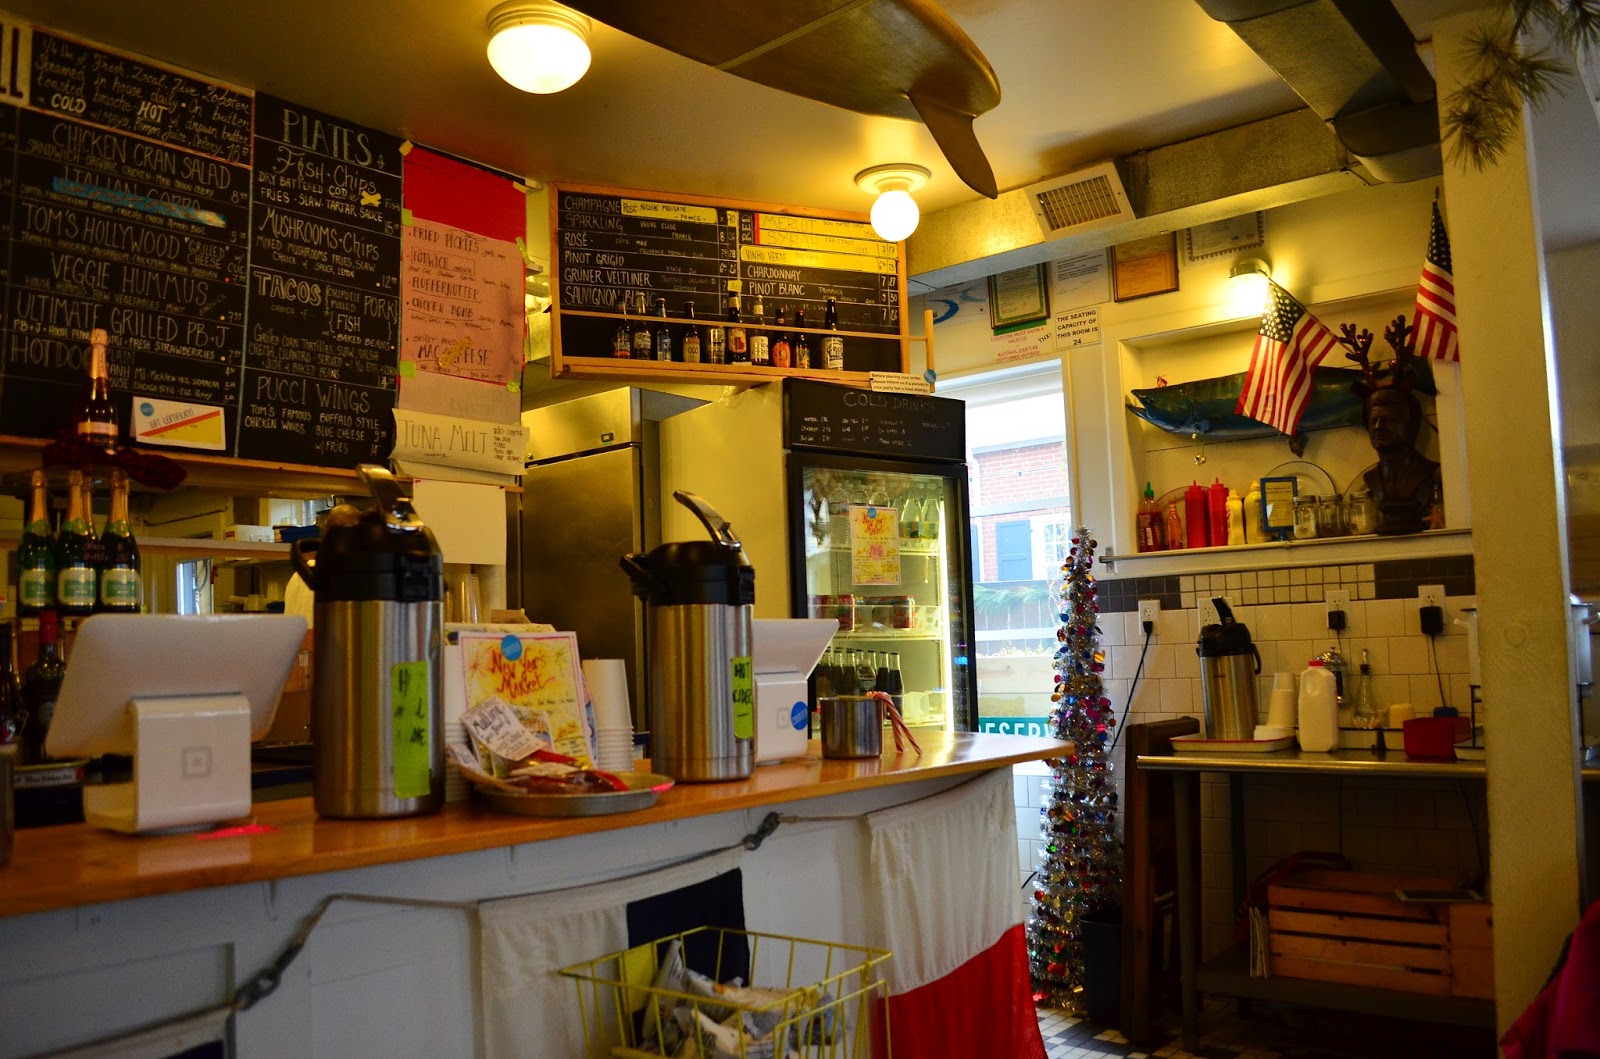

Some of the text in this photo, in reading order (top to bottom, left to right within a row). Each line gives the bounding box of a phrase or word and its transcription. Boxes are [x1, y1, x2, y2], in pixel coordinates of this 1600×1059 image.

[51, 93, 87, 114] COLD
[137, 101, 168, 124] HOT
[282, 109, 372, 166] PLATES
[52, 122, 231, 189] CHICKEN CRAN SALAD
[258, 170, 348, 198] DRY BATTERED COD
[260, 187, 384, 223] FRIES SLAW TARTAR SAUCE
[564, 195, 620, 214] CHAMPAGNE
[21, 202, 180, 259] TOM'S HOLLYWOOD
[258, 207, 380, 261] MUSHROOMS Chips
[565, 213, 624, 234] SPARKLING
[741, 214, 752, 242] RED
[762, 215, 817, 234] MERLOT
[256, 235, 283, 251] MIXED
[287, 242, 328, 263] MUSHROOMS
[413, 226, 480, 254] FRIED PICKLES
[564, 231, 588, 247] ROSÉ
[767, 231, 819, 250] SYRAH
[187, 253, 222, 270] CHEESE
[272, 250, 297, 266] CHOICE
[564, 249, 625, 267] PINOT GRIGIO
[745, 249, 765, 260] VINHO
[51, 251, 111, 289] VEGGIE
[121, 265, 209, 306] HUMMUS
[607, 270, 653, 288] VELTLINER
[747, 265, 896, 287] CHARDONNAY 7 27
[253, 270, 322, 307] TACOS
[363, 295, 395, 321] PORK
[412, 277, 480, 301] FLUFFERNUTTER
[749, 281, 897, 303] PINOT BLANC 30
[16, 291, 179, 342] ULTIMATE GRILLED
[411, 297, 474, 318] CHICKEN BOMB
[1070, 309, 1097, 321] SEATING
[337, 313, 361, 333] FISH
[1057, 320, 1087, 331] CAPACITY
[1057, 326, 1099, 340] THIS ROOM IS
[128, 337, 215, 360] FRESH STRAWBERRIES
[282, 335, 299, 349] CORN
[336, 333, 390, 352] BAKED BEANS
[1038, 332, 1052, 344] THX!
[1073, 338, 1082, 346] 24
[278, 347, 311, 362] CILANTRO
[417, 344, 440, 360] MAC
[997, 350, 1018, 358] ALCOHOL
[292, 362, 316, 376] BAKED
[319, 367, 340, 380] BEANS
[256, 376, 370, 414] PUCCI WINGS
[843, 391, 936, 411] COLD DRINKS
[249, 402, 380, 430] TOM'S FAMOUS BUFFALO STYLE
[244, 415, 366, 442] CHICKEN WINGS BLUE CHEESE
[398, 418, 443, 450] TUNA
[448, 424, 488, 454] MELT
[326, 441, 350, 455] FRIES
[488, 648, 516, 679] New
[496, 671, 557, 699] Market
